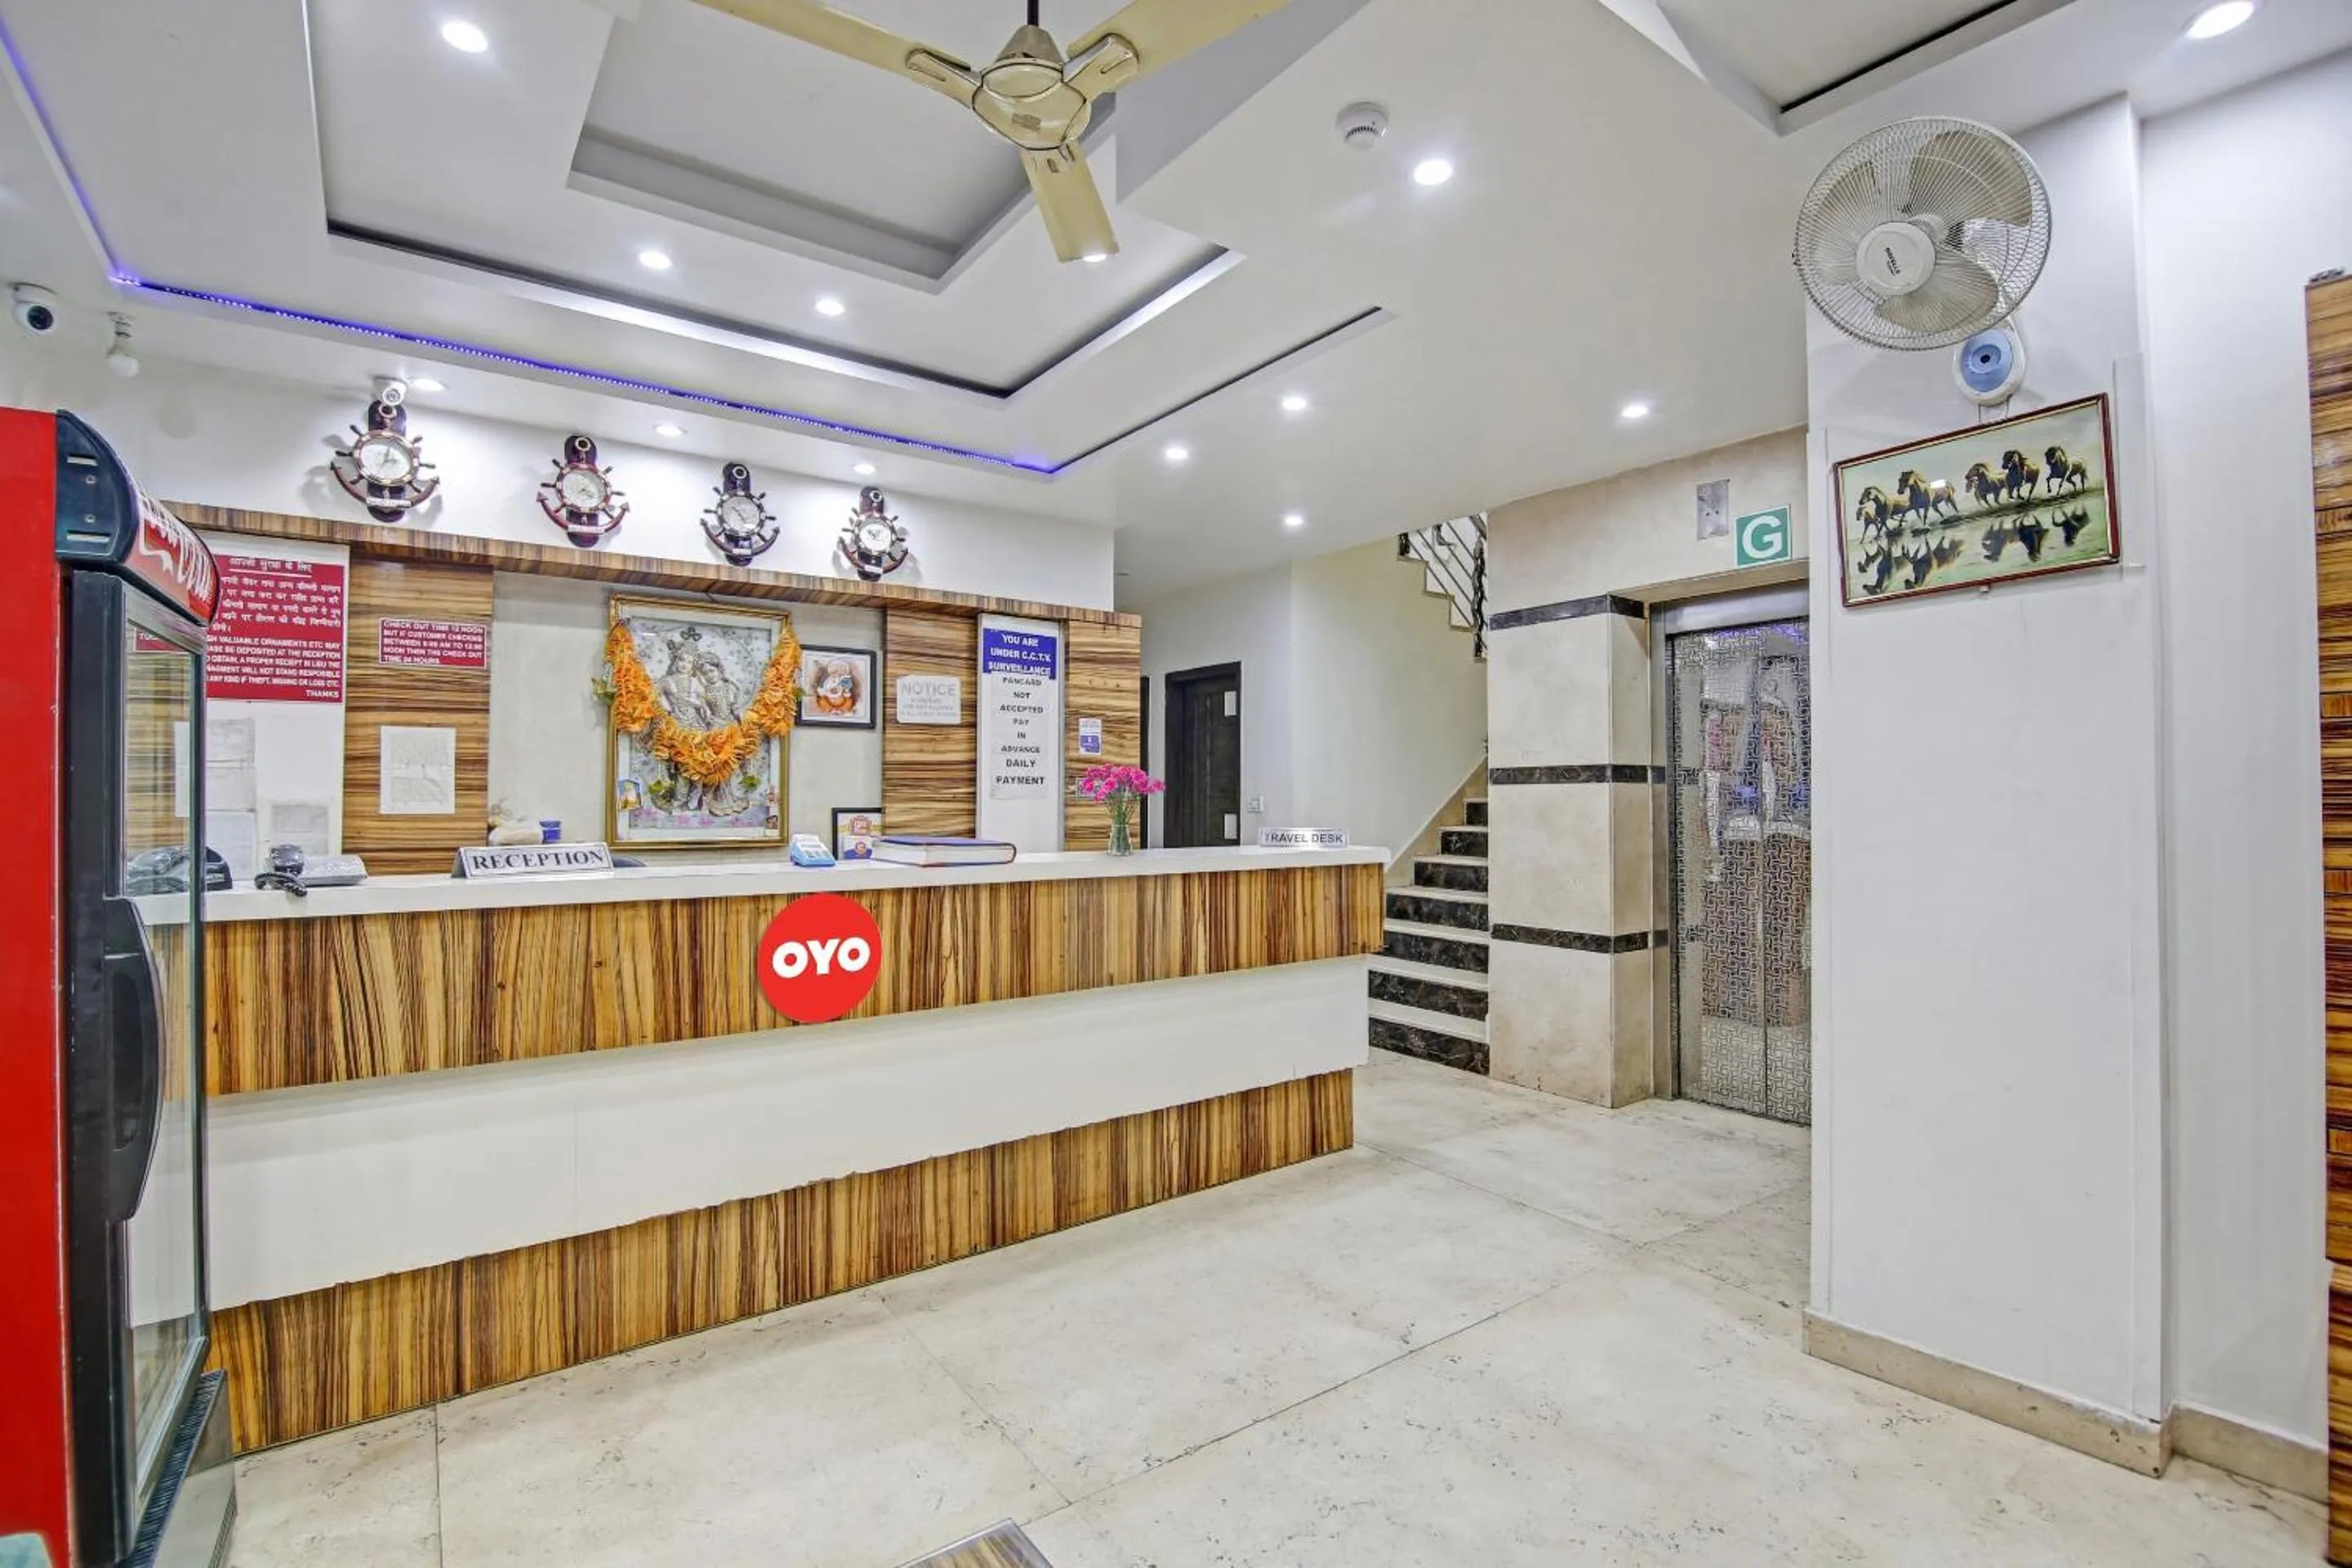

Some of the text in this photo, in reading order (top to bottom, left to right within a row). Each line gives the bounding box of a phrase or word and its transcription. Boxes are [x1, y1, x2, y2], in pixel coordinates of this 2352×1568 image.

[1742, 515, 1782, 559] G
[1002, 633, 1039, 647] YOU ARE
[302, 650, 341, 659] RECEPTION
[991, 648, 1020, 659] UNDER
[988, 661, 1051, 677] SURVEILLANCE
[305, 688, 340, 698] THANKS
[901, 682, 957, 697] NOTICE
[1013, 691, 1031, 700] NOT
[1000, 704, 1044, 715] ACCEPTED
[1013, 718, 1030, 727] PAY
[1017, 732, 1027, 740] IN
[1001, 745, 1041, 754] ADVANCE
[1006, 759, 1036, 768] DAILY
[996, 775, 1045, 786] PAYMENT
[1265, 832, 1343, 844] TRAVEL DESK
[472, 850, 604, 870] RECEPTION
[772, 937, 871, 979] OYO
